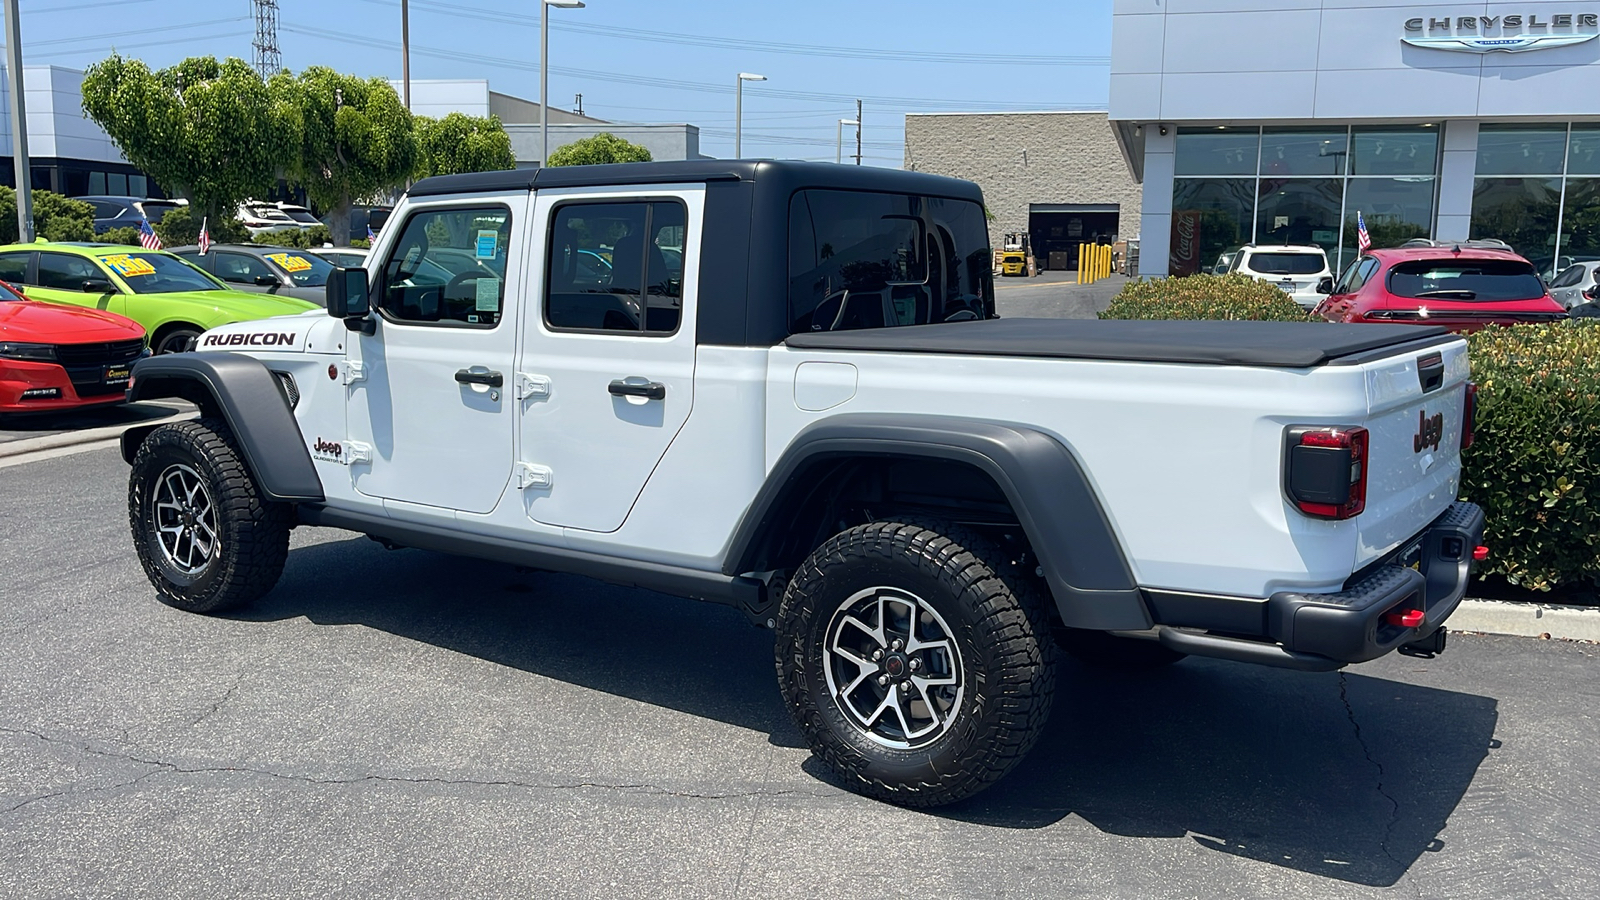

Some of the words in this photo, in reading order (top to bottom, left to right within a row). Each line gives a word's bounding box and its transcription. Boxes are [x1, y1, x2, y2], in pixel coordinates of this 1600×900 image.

[1404, 14, 1598, 31] CHRYSLER
[26, 221, 34, 229] 12
[203, 333, 296, 346] RUBICON
[1414, 410, 1443, 453] Jeep
[313, 436, 342, 457] Jeep
